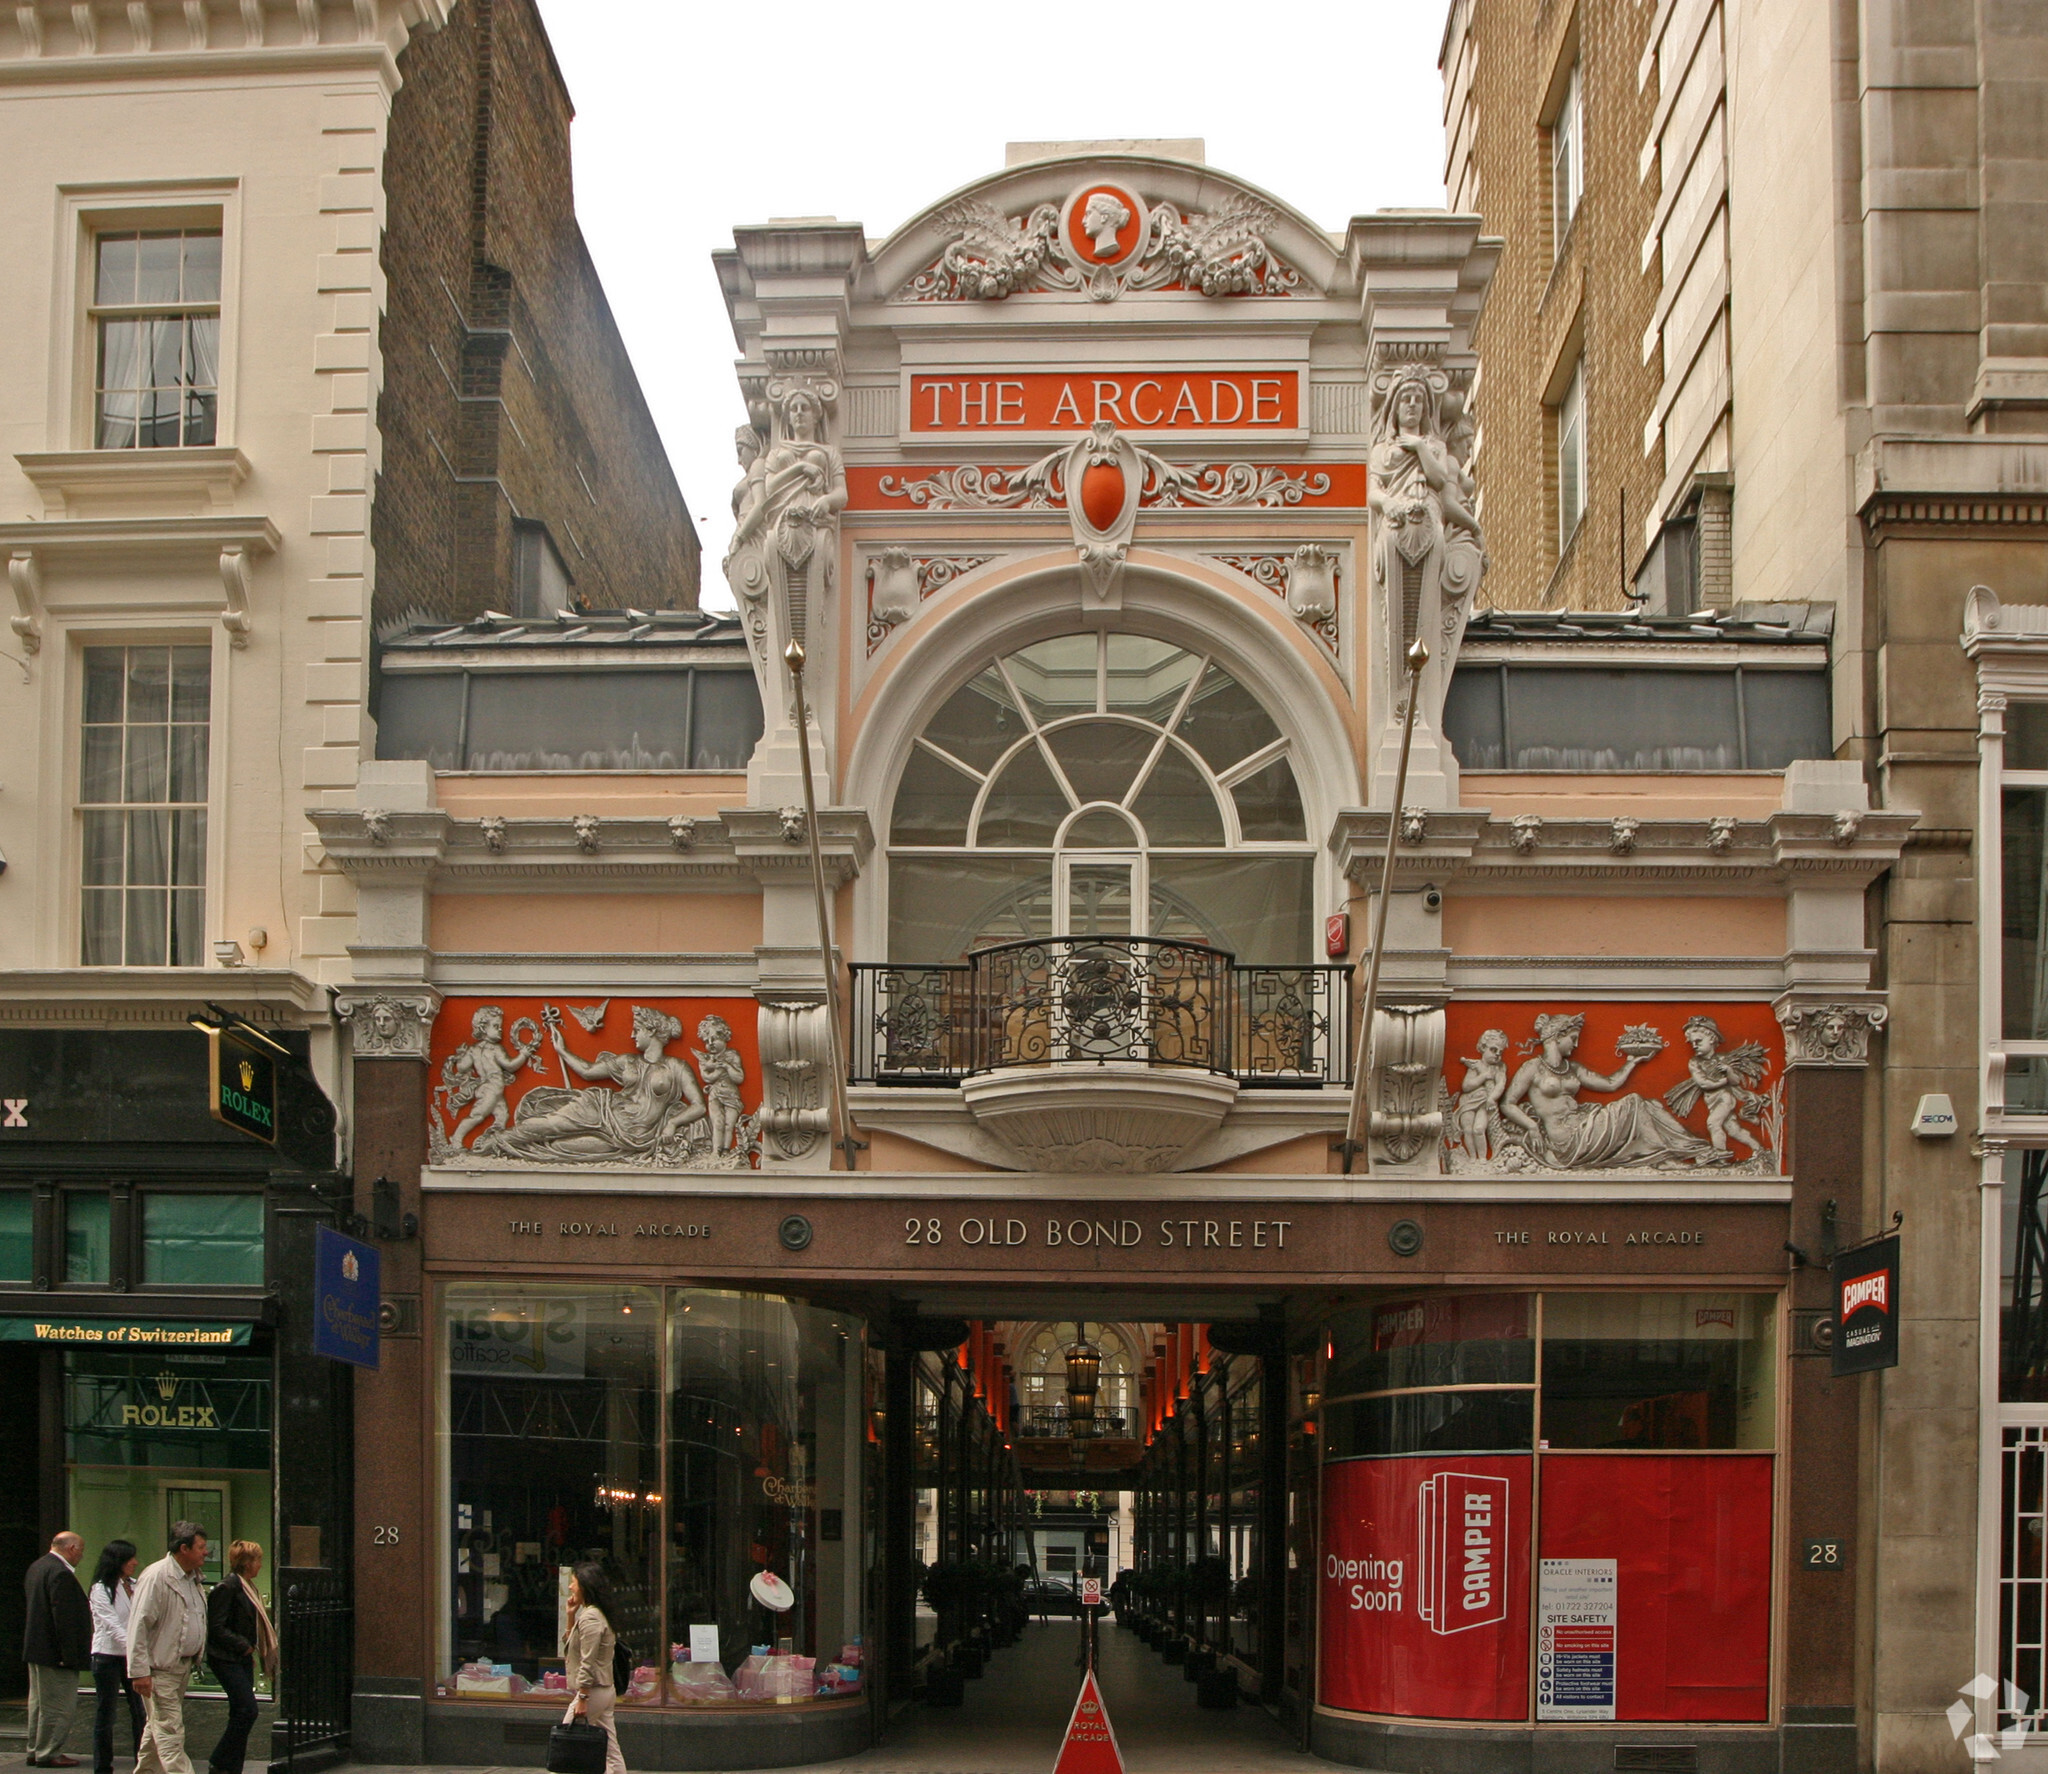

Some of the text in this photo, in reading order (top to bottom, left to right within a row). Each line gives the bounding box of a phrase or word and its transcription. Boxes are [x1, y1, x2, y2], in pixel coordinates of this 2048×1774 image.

[920, 379, 1283, 426] THE ARCADE
[0, 1098, 28, 1127] X
[222, 1084, 272, 1127] ROLEX
[509, 1221, 710, 1238] THE ROYAL ARCADE
[905, 1218, 1291, 1248] 28 OLD BOND STREET
[1494, 1231, 1704, 1244] THE ROYAL ARCADE
[1844, 1275, 1885, 1314] CAMPER
[1698, 1310, 1732, 1325] CAMPER
[34, 1324, 233, 1343] Watches of Switzerland
[1846, 1326, 1870, 1338] CASUAL
[122, 1405, 214, 1427] ROLEX
[374, 1526, 399, 1544] 28
[1462, 1493, 1491, 1611] CAMPER
[1810, 1544, 1837, 1563] 28
[1327, 1553, 1403, 1589] Opening
[1543, 1568, 1613, 1576] ORACLE INTERIORS
[1350, 1584, 1401, 1611] Soon
[1542, 1602, 1613, 1611] tel: 01722 327204
[1547, 1614, 1607, 1623] SITE SAFETY
[1073, 1721, 1106, 1730] ROYAL
[1069, 1733, 1109, 1742] ARCADE
